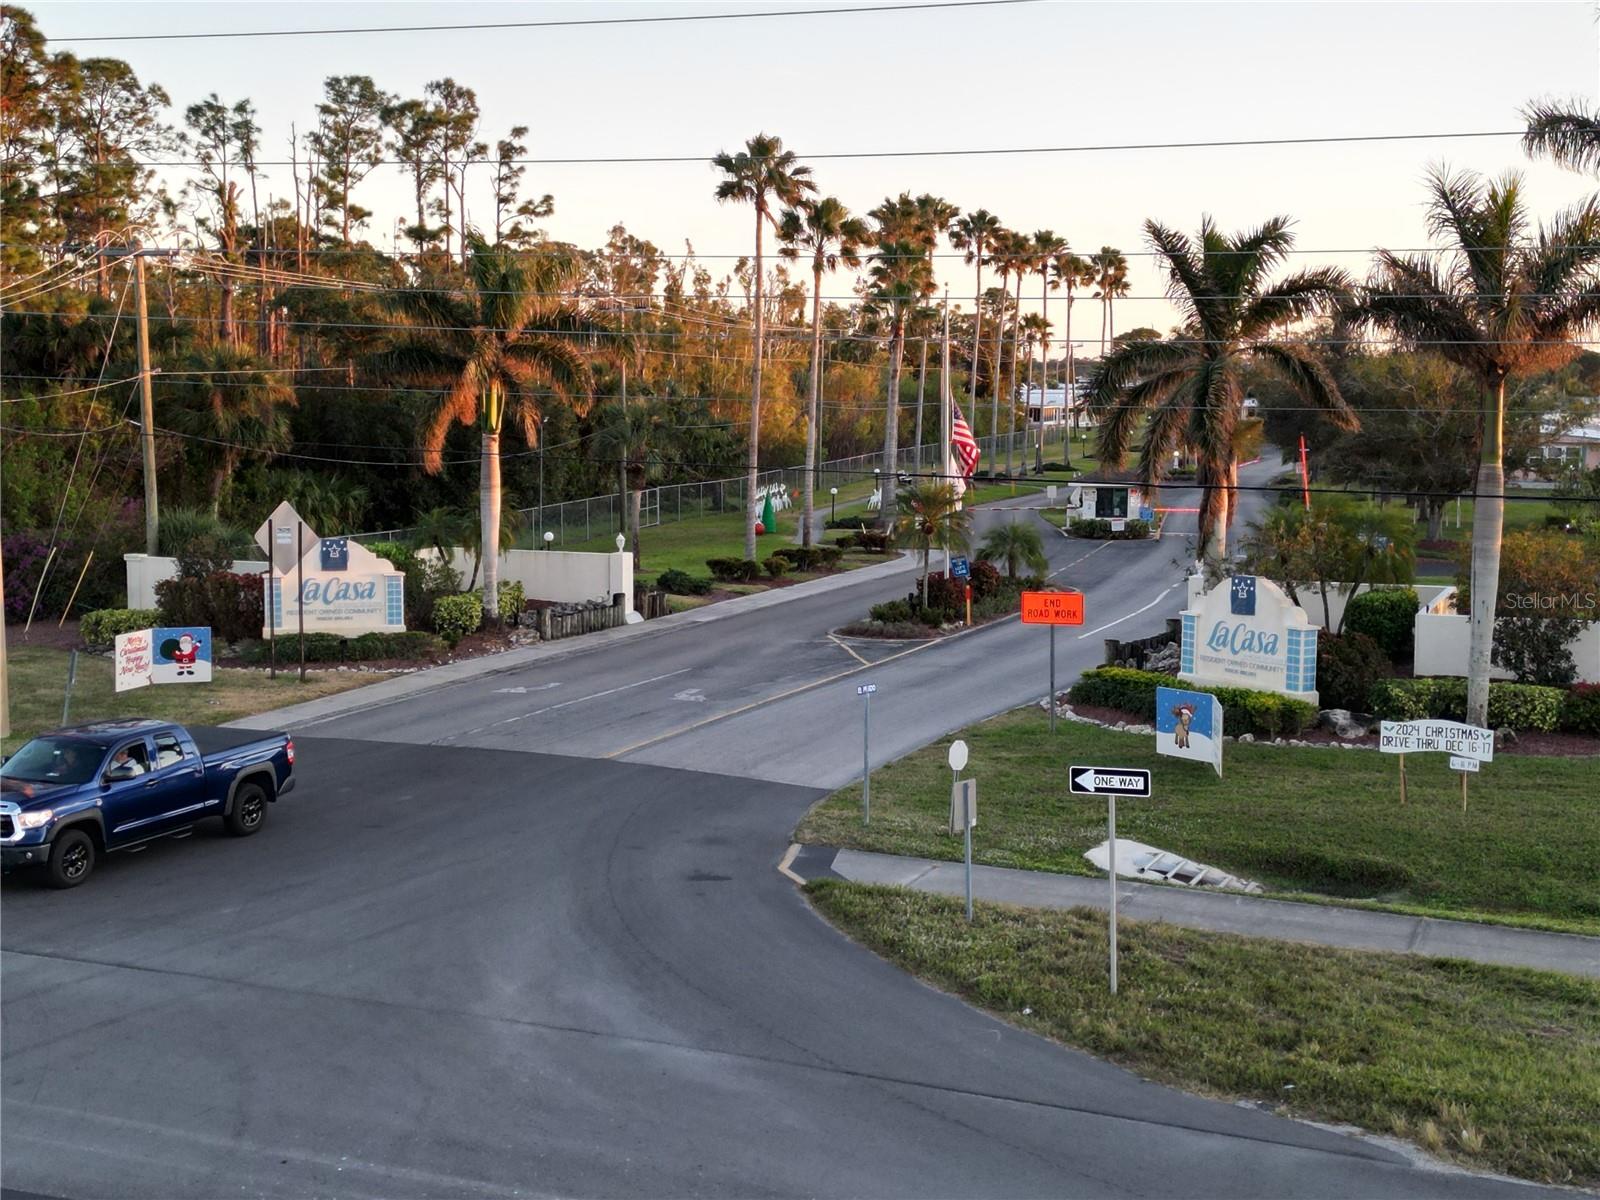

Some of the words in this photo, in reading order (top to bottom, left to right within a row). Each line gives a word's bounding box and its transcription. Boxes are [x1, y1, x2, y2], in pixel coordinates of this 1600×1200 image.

[322, 577, 376, 605] Casa
[1044, 598, 1061, 608] END
[286, 608, 318, 616] RESENT
[1027, 608, 1050, 618] ROAD
[1054, 609, 1078, 619] WORK
[1206, 620, 1229, 652] La
[1229, 623, 1279, 656] Casa
[1396, 723, 1421, 736] 2024
[1425, 726, 1480, 740] CHRISTMAS
[1446, 740, 1463, 752] DEC
[1468, 742, 1491, 754] 16-17
[1094, 776, 1115, 786] ONE
[1119, 777, 1140, 788] WAY
